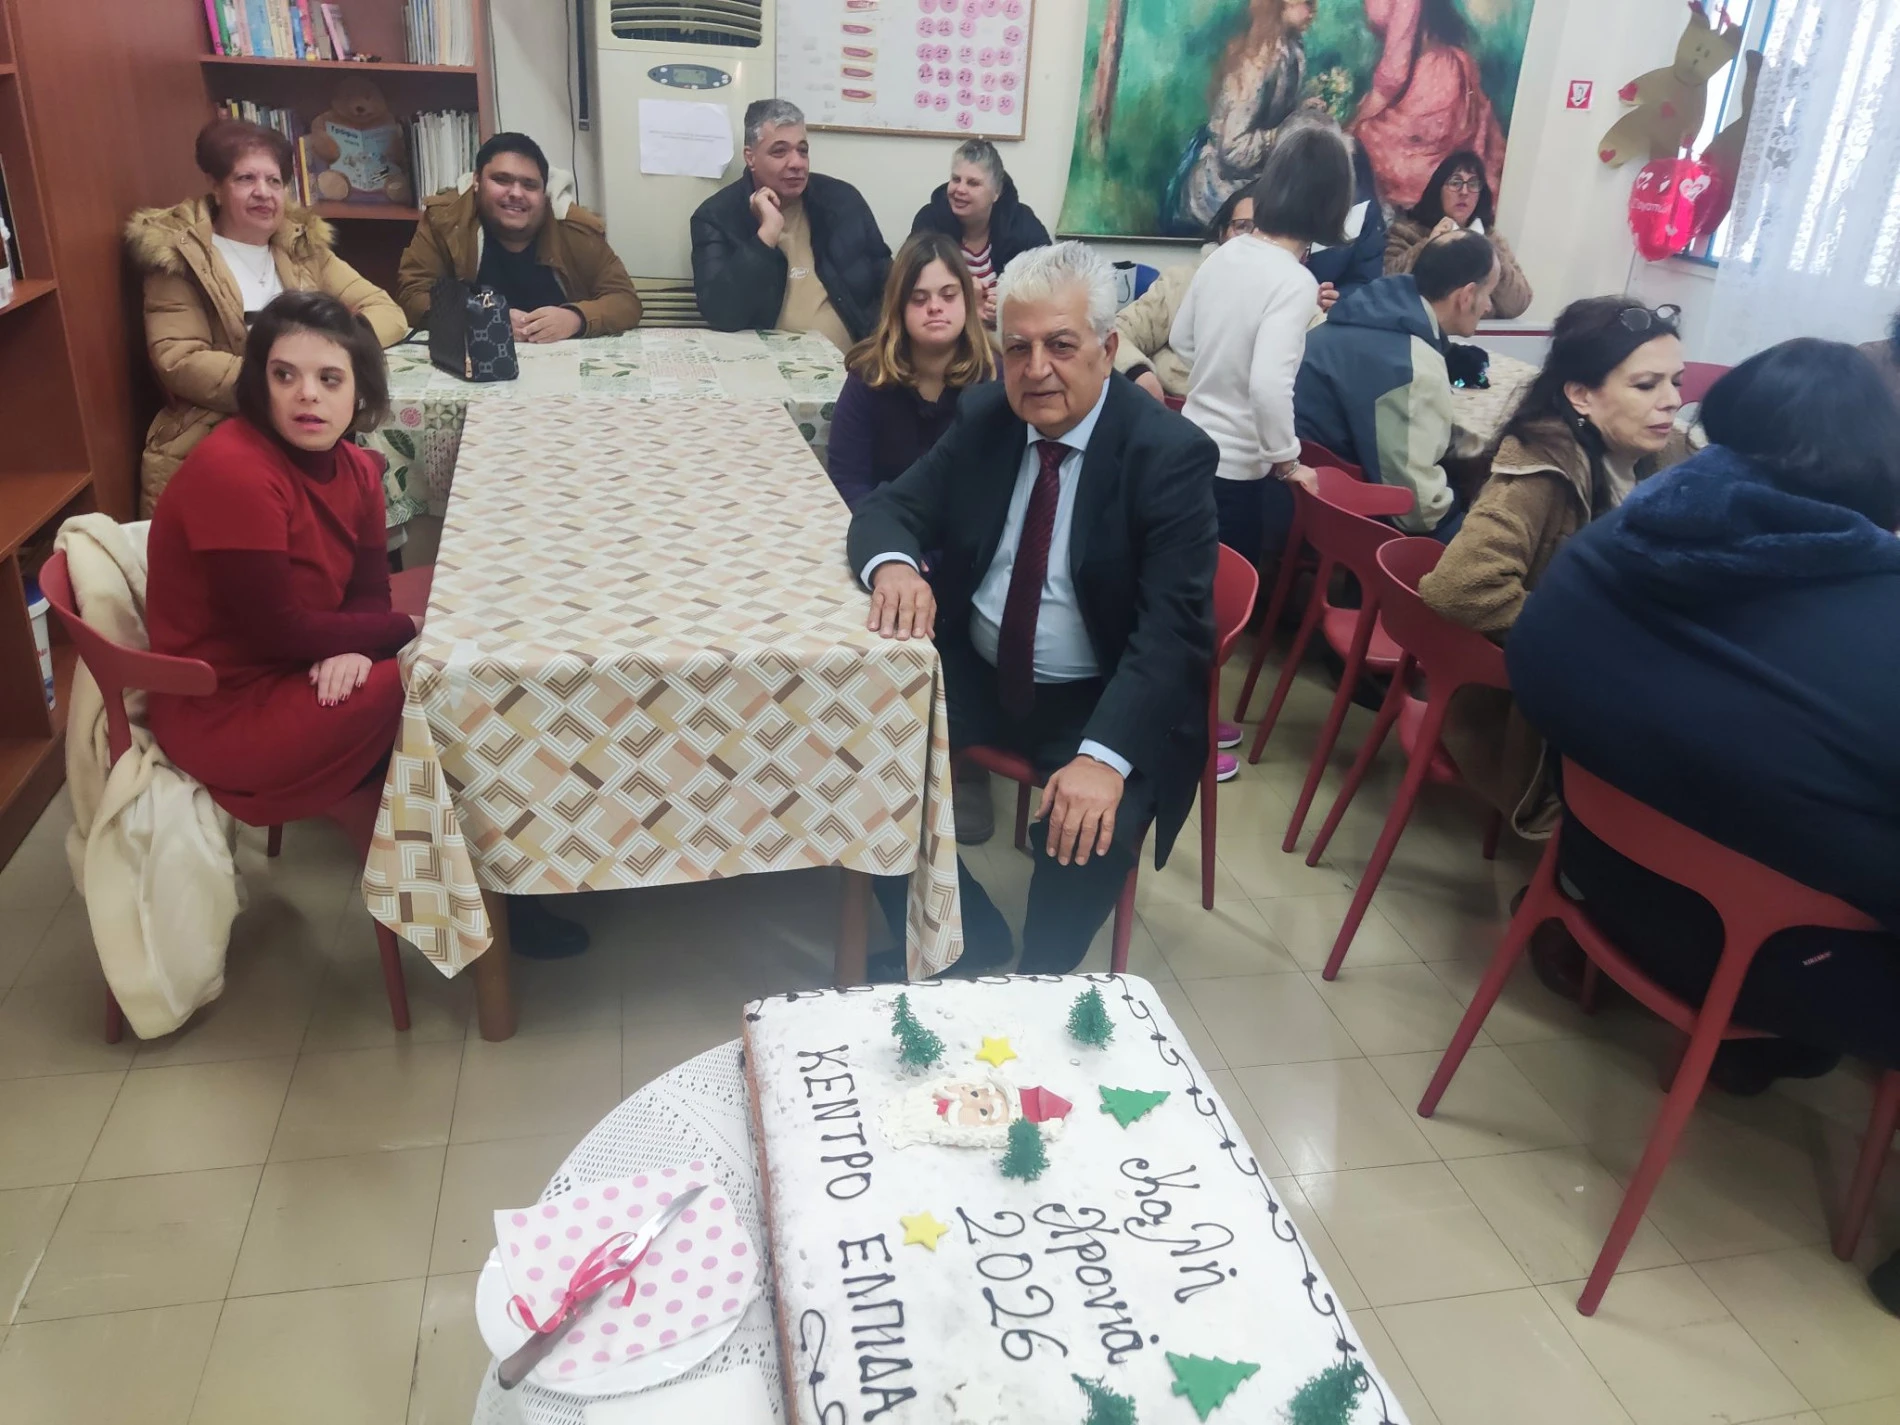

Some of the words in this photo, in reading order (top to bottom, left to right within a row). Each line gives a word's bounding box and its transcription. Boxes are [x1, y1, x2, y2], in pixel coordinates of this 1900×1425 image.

[797, 1044, 874, 1200] ΚΕΝΤΡΟ
[838, 1233, 917, 1422] ΕΛΠΙΔΑ
[955, 1206, 1069, 1362] 2026
